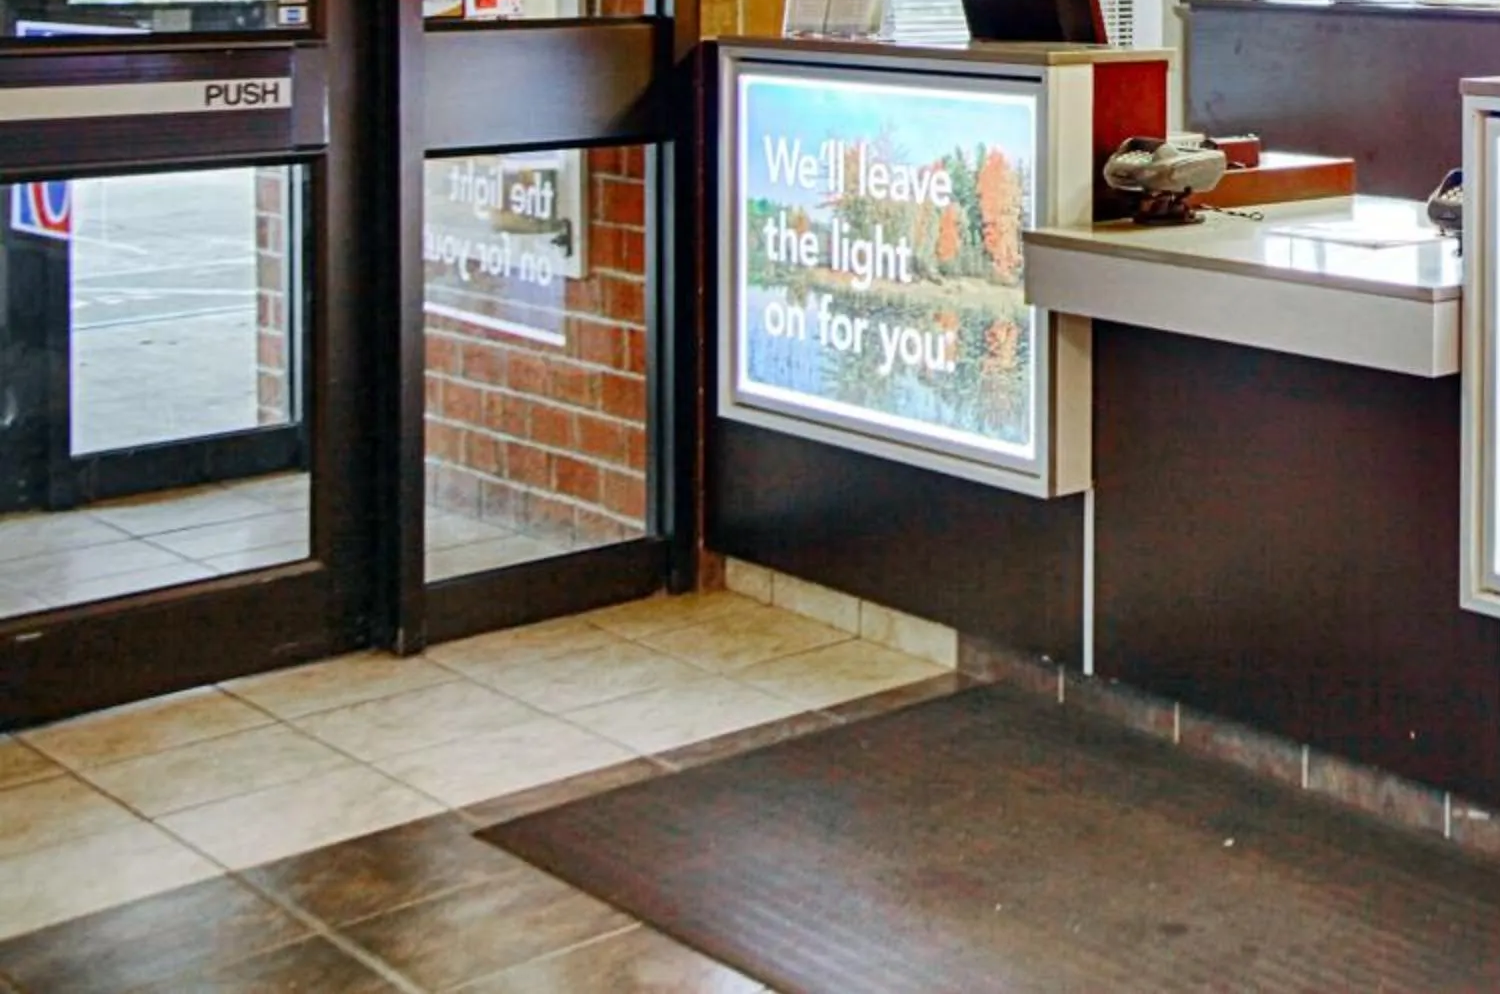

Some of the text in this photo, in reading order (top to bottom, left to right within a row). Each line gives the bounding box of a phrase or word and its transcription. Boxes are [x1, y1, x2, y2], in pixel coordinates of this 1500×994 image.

[204, 82, 280, 107] PUSH
[764, 134, 953, 206] We'll leave
[763, 211, 913, 291] the light
[763, 301, 806, 342] on
[817, 300, 868, 355] for
